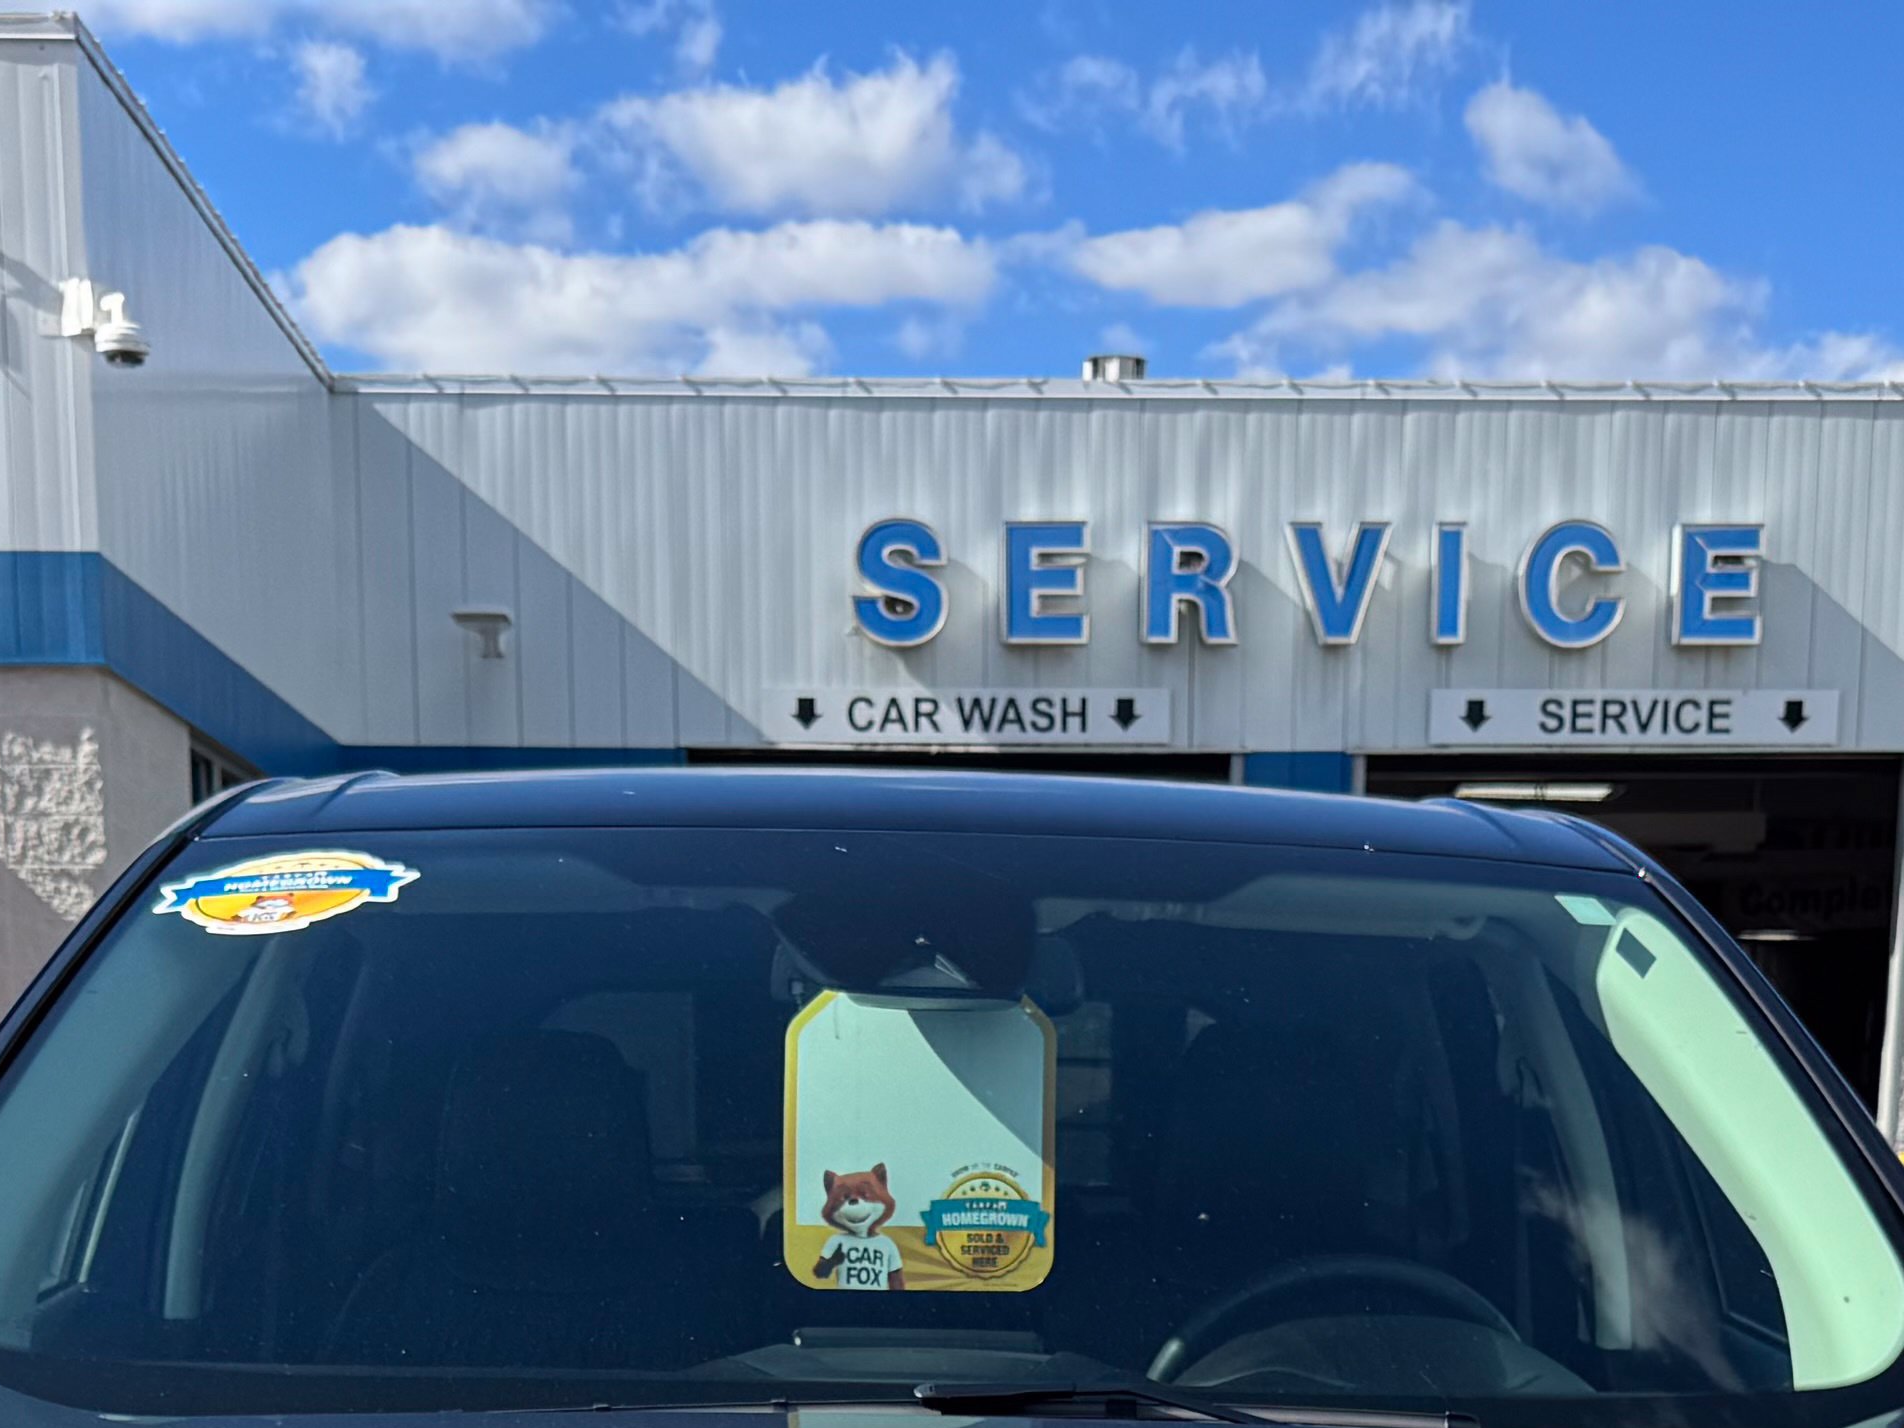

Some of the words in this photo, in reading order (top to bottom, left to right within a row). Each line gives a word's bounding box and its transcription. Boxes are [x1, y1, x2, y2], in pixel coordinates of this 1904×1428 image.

[852, 517, 1766, 648] SERVICE
[847, 697, 940, 733] CAR
[957, 697, 1087, 733] WASH
[1538, 698, 1733, 735] SERVICE
[1738, 874, 1884, 923] Comple
[941, 1212, 1029, 1227] HOMEGROWN
[966, 1233, 993, 1243] SOLD
[847, 1246, 884, 1268] CAR
[846, 1267, 883, 1288] FOX
